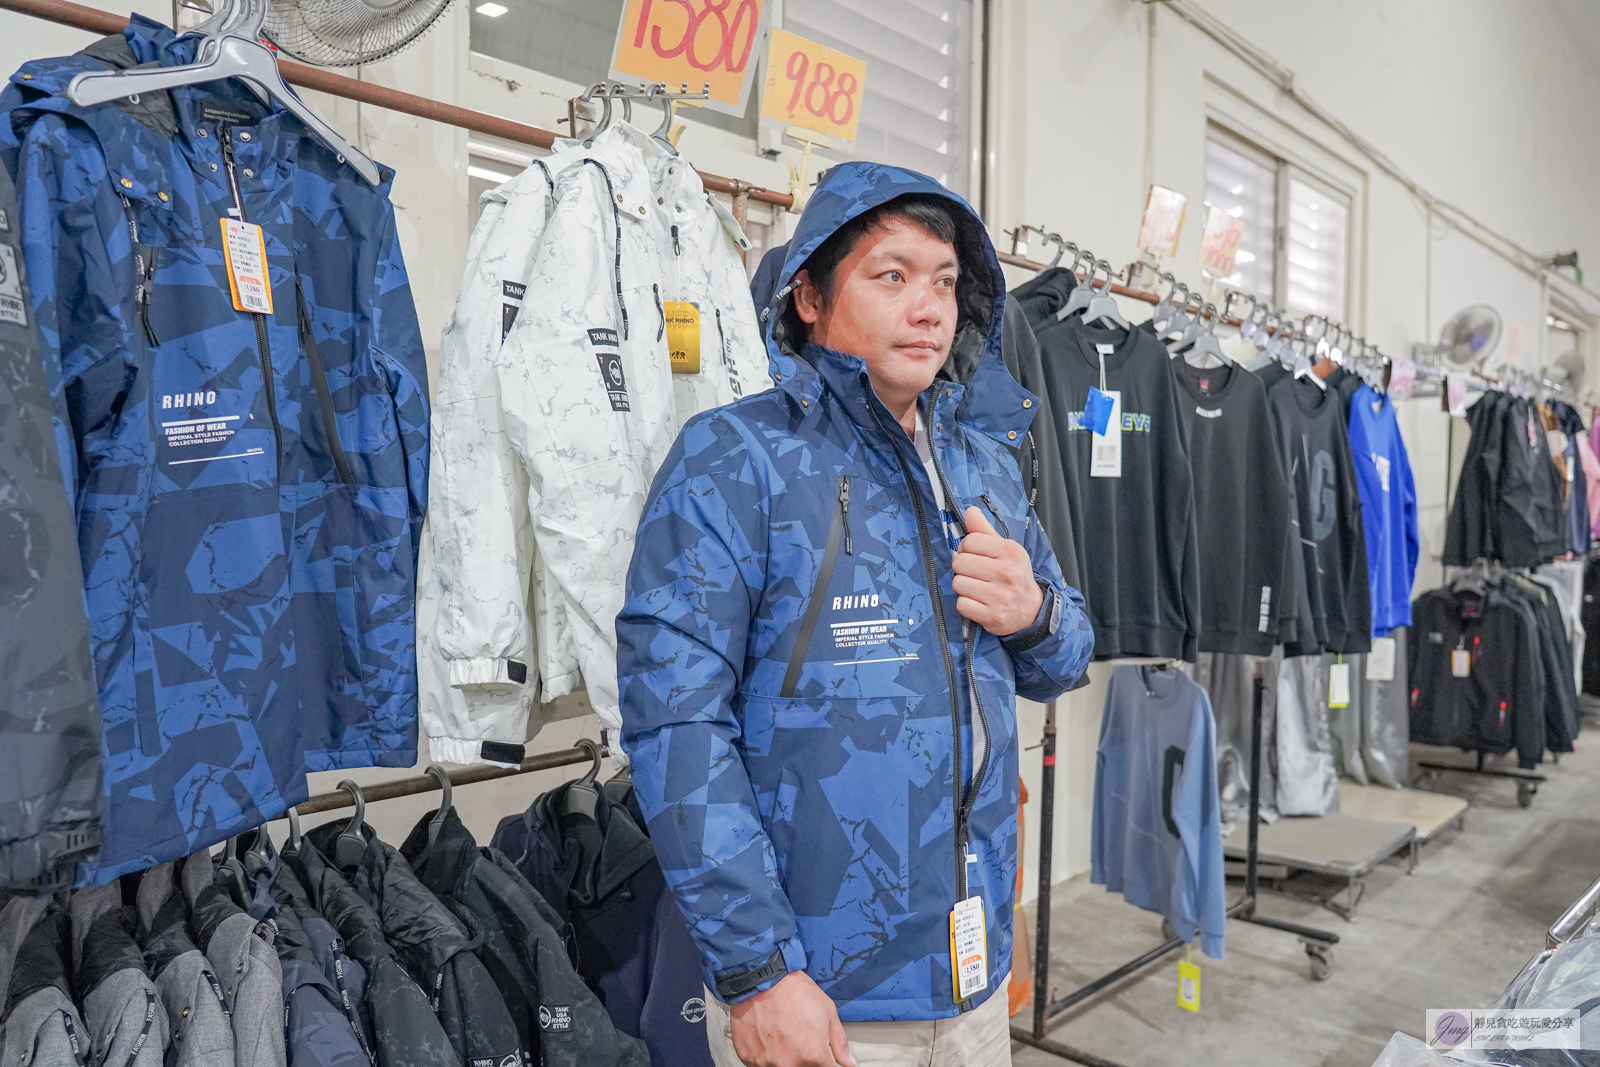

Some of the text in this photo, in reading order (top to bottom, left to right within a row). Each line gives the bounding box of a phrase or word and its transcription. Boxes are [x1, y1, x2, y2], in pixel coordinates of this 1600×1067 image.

[786, 51, 857, 126] 988
[505, 285, 524, 296] TANK
[592, 332, 609, 341] TANK
[162, 390, 217, 409] RHINO
[165, 422, 227, 436] FASHION OF WEAR
[169, 439, 204, 447] COLLECTION
[832, 594, 879, 611] RHINO
[833, 625, 887, 636] FASHION OF WEAR
[131, 1033, 148, 1055] FASHION
